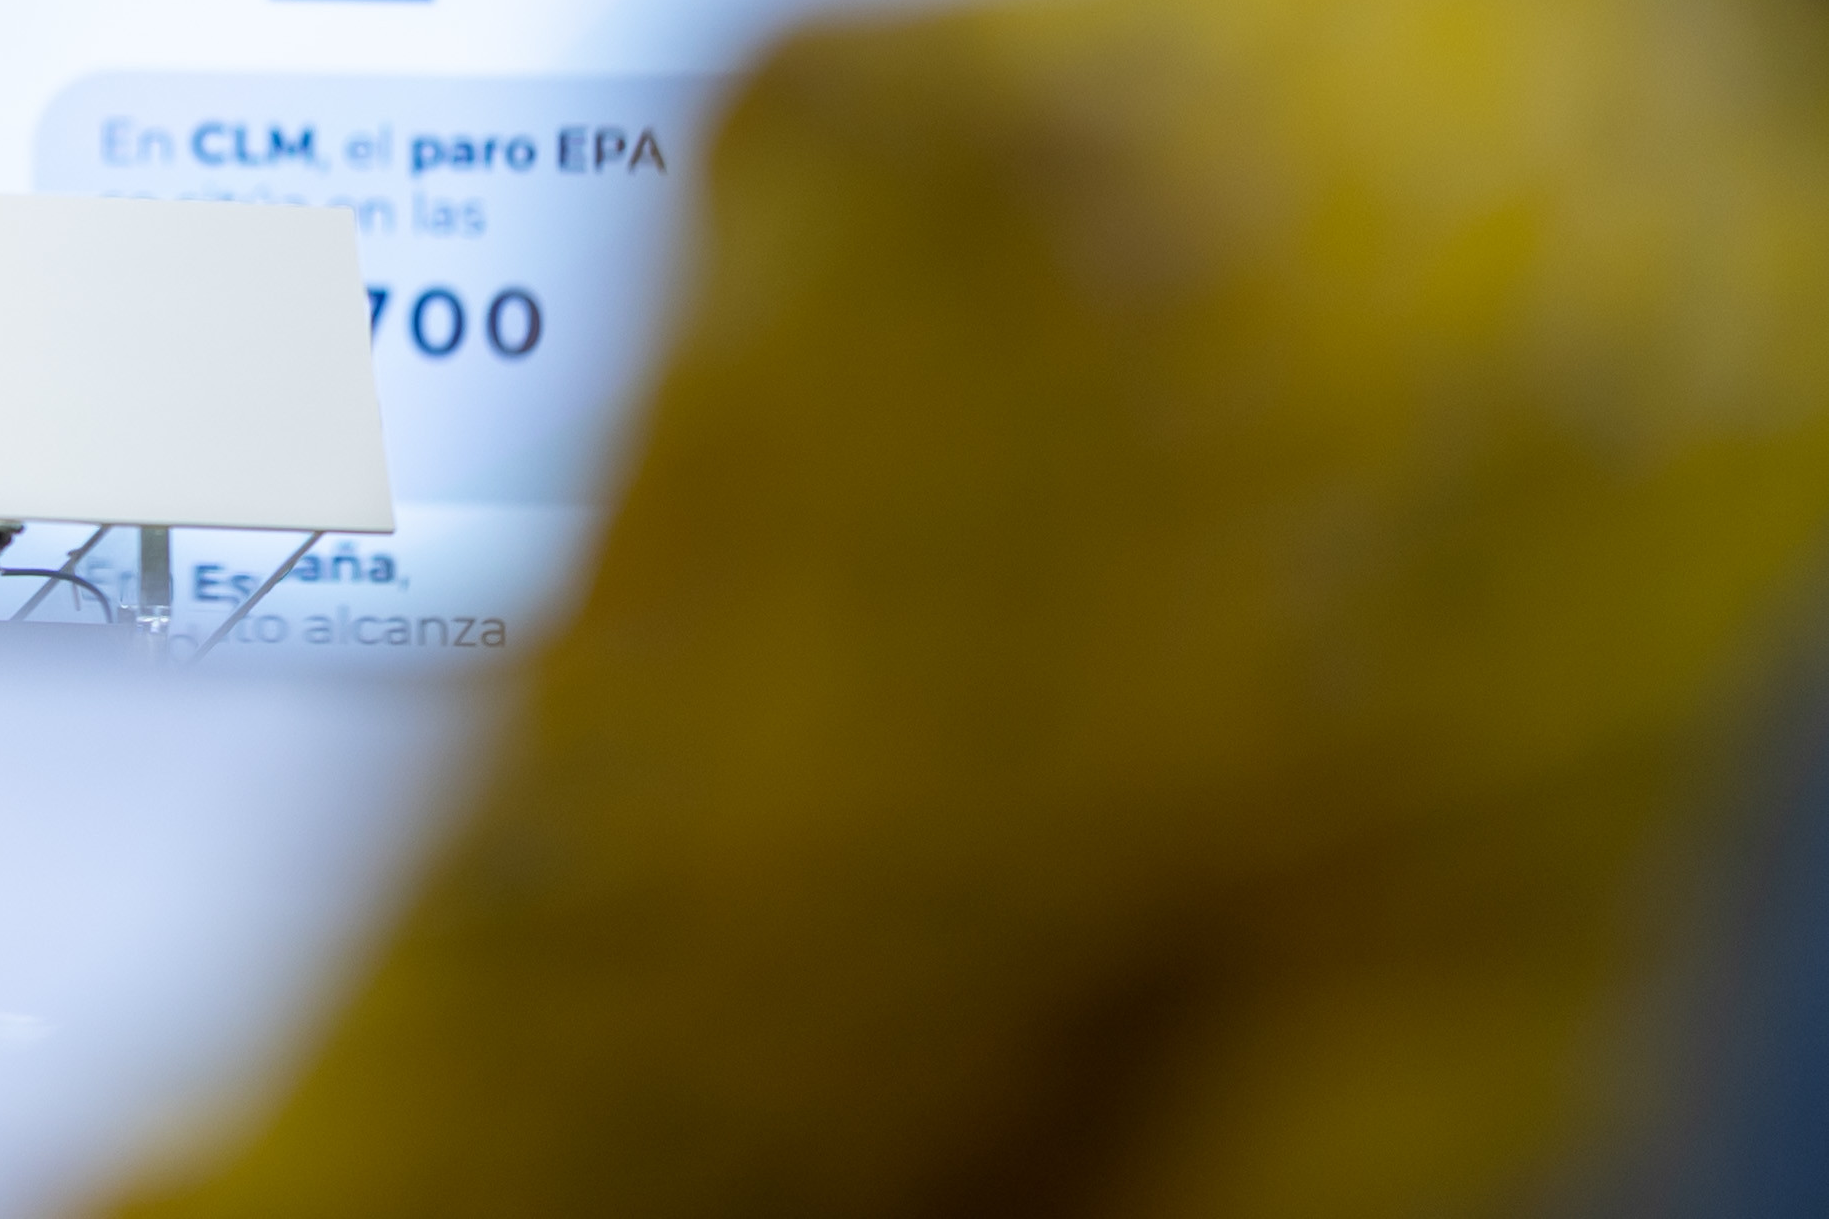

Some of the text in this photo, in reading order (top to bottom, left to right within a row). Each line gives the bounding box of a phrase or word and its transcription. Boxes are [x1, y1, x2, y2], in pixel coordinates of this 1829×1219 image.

[100, 118, 669, 178] En CLM, el paro EPA
[412, 189, 488, 238] las
[192, 541, 411, 609] Esaña,
[302, 605, 507, 648] alcanza
